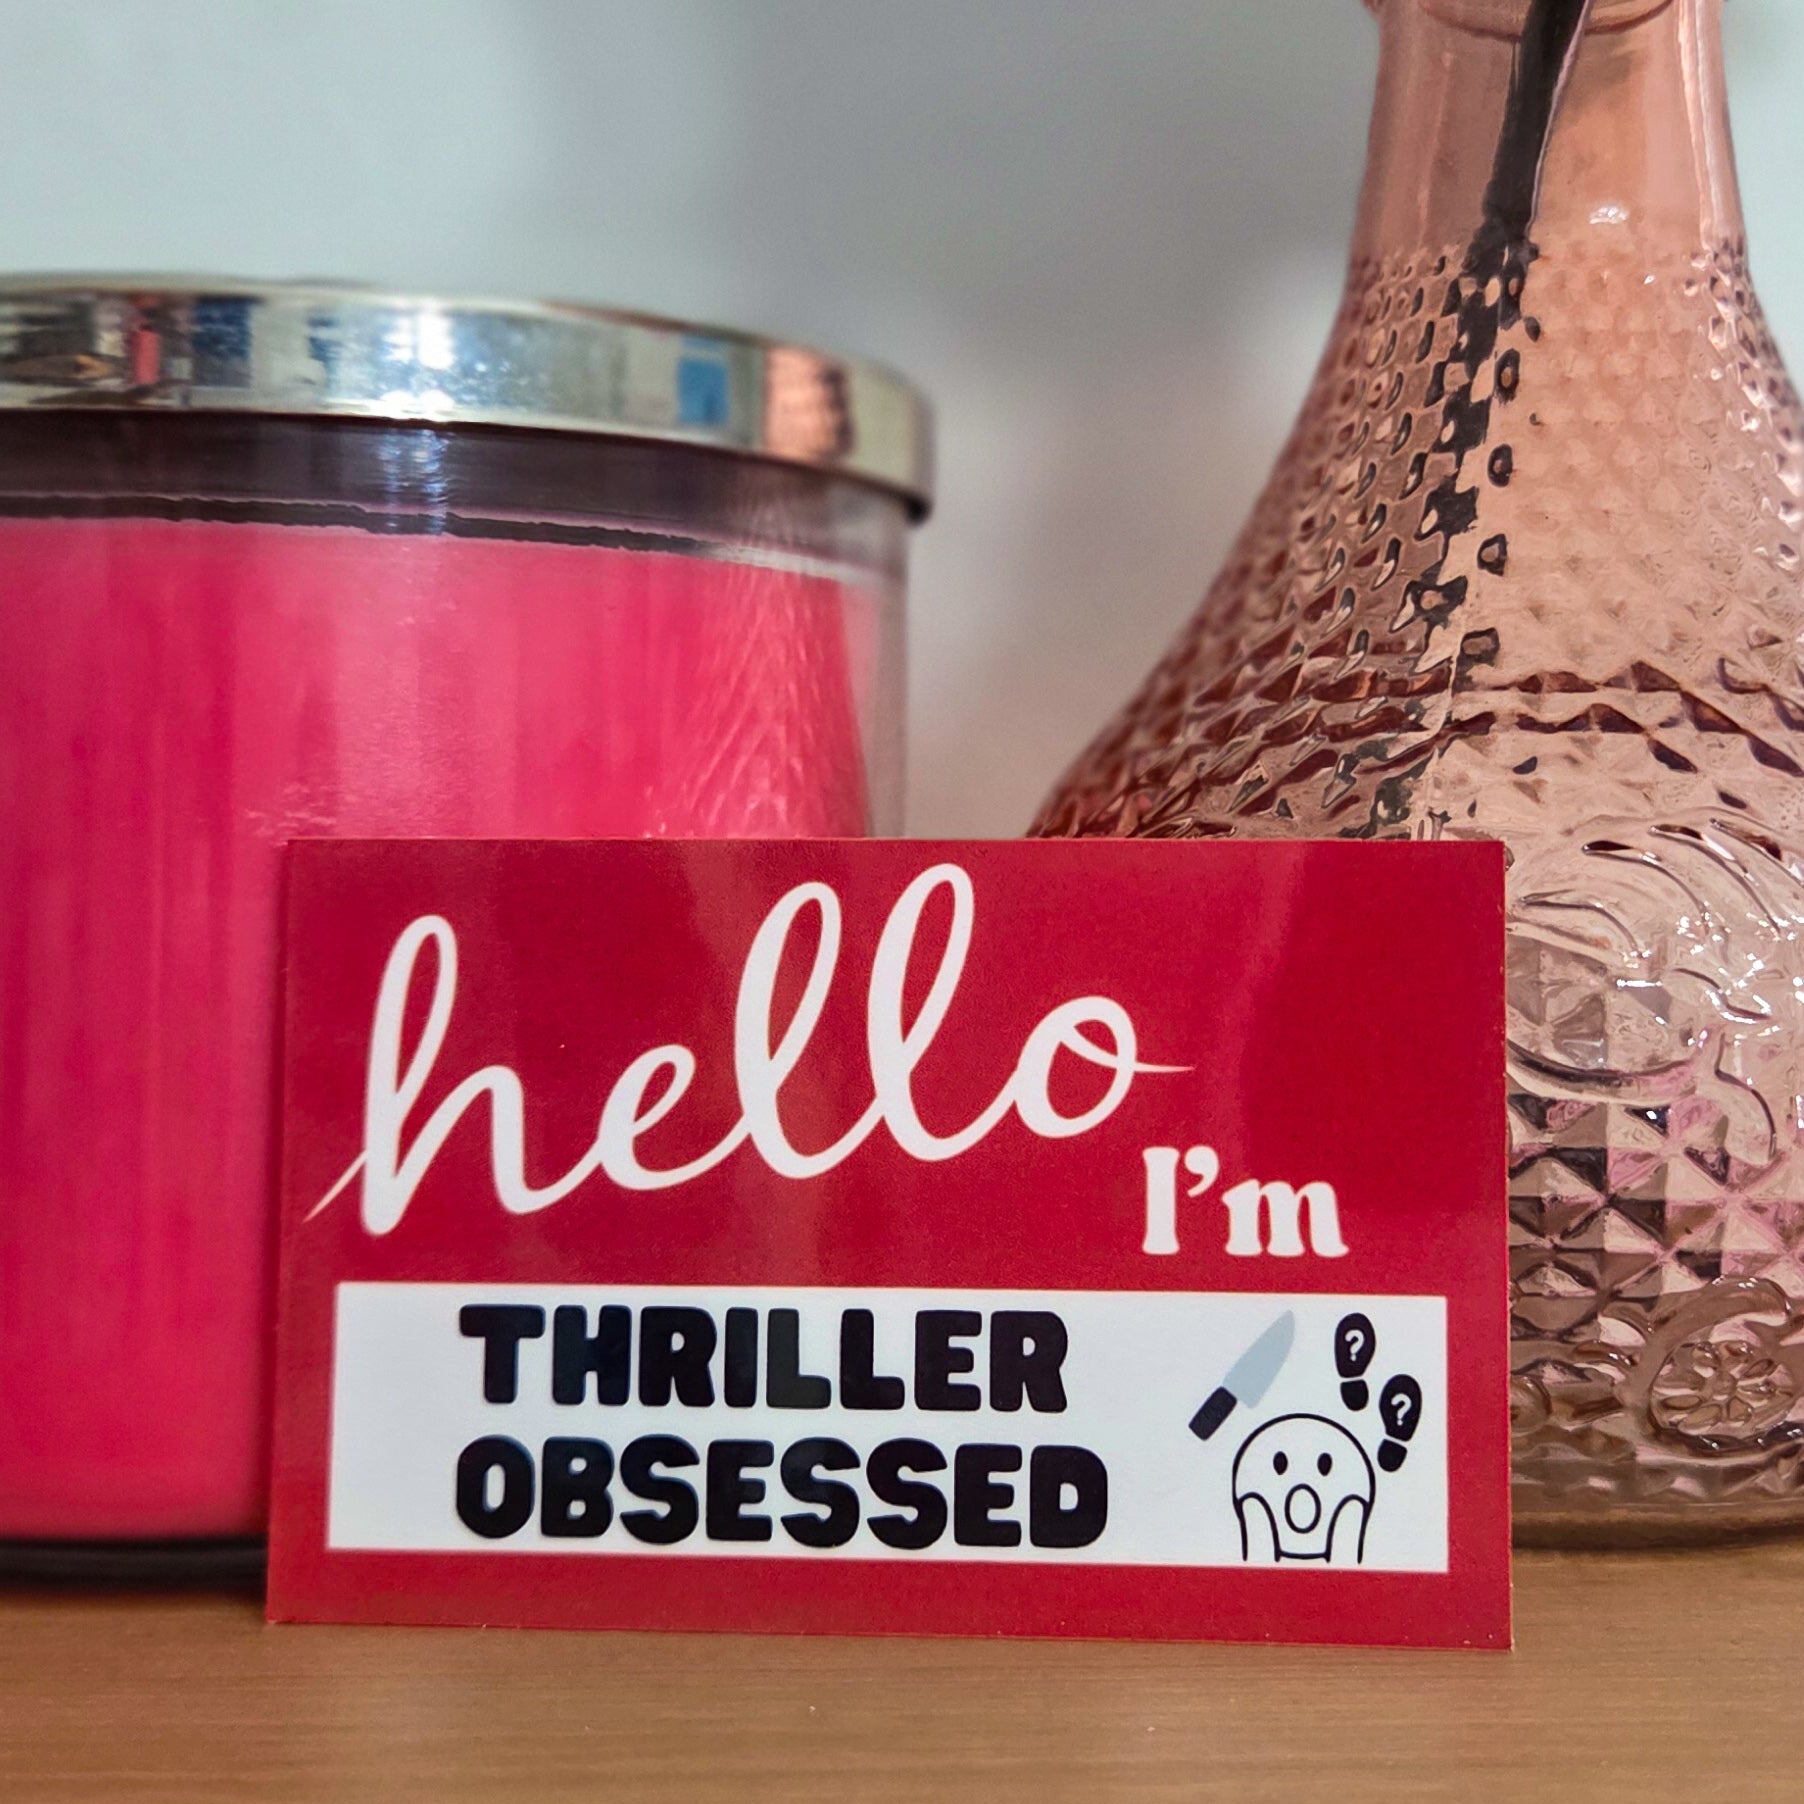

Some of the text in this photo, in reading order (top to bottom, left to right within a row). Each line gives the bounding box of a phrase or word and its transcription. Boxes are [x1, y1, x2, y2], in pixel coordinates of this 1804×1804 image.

[306, 862, 1193, 1238] hello
[1140, 1144, 1350, 1260] I'm
[457, 1302, 1071, 1415] THRILLER
[1344, 1329, 1366, 1362] ?
[1390, 1393, 1412, 1426] ?
[454, 1434, 1109, 1551] OBSESSED
